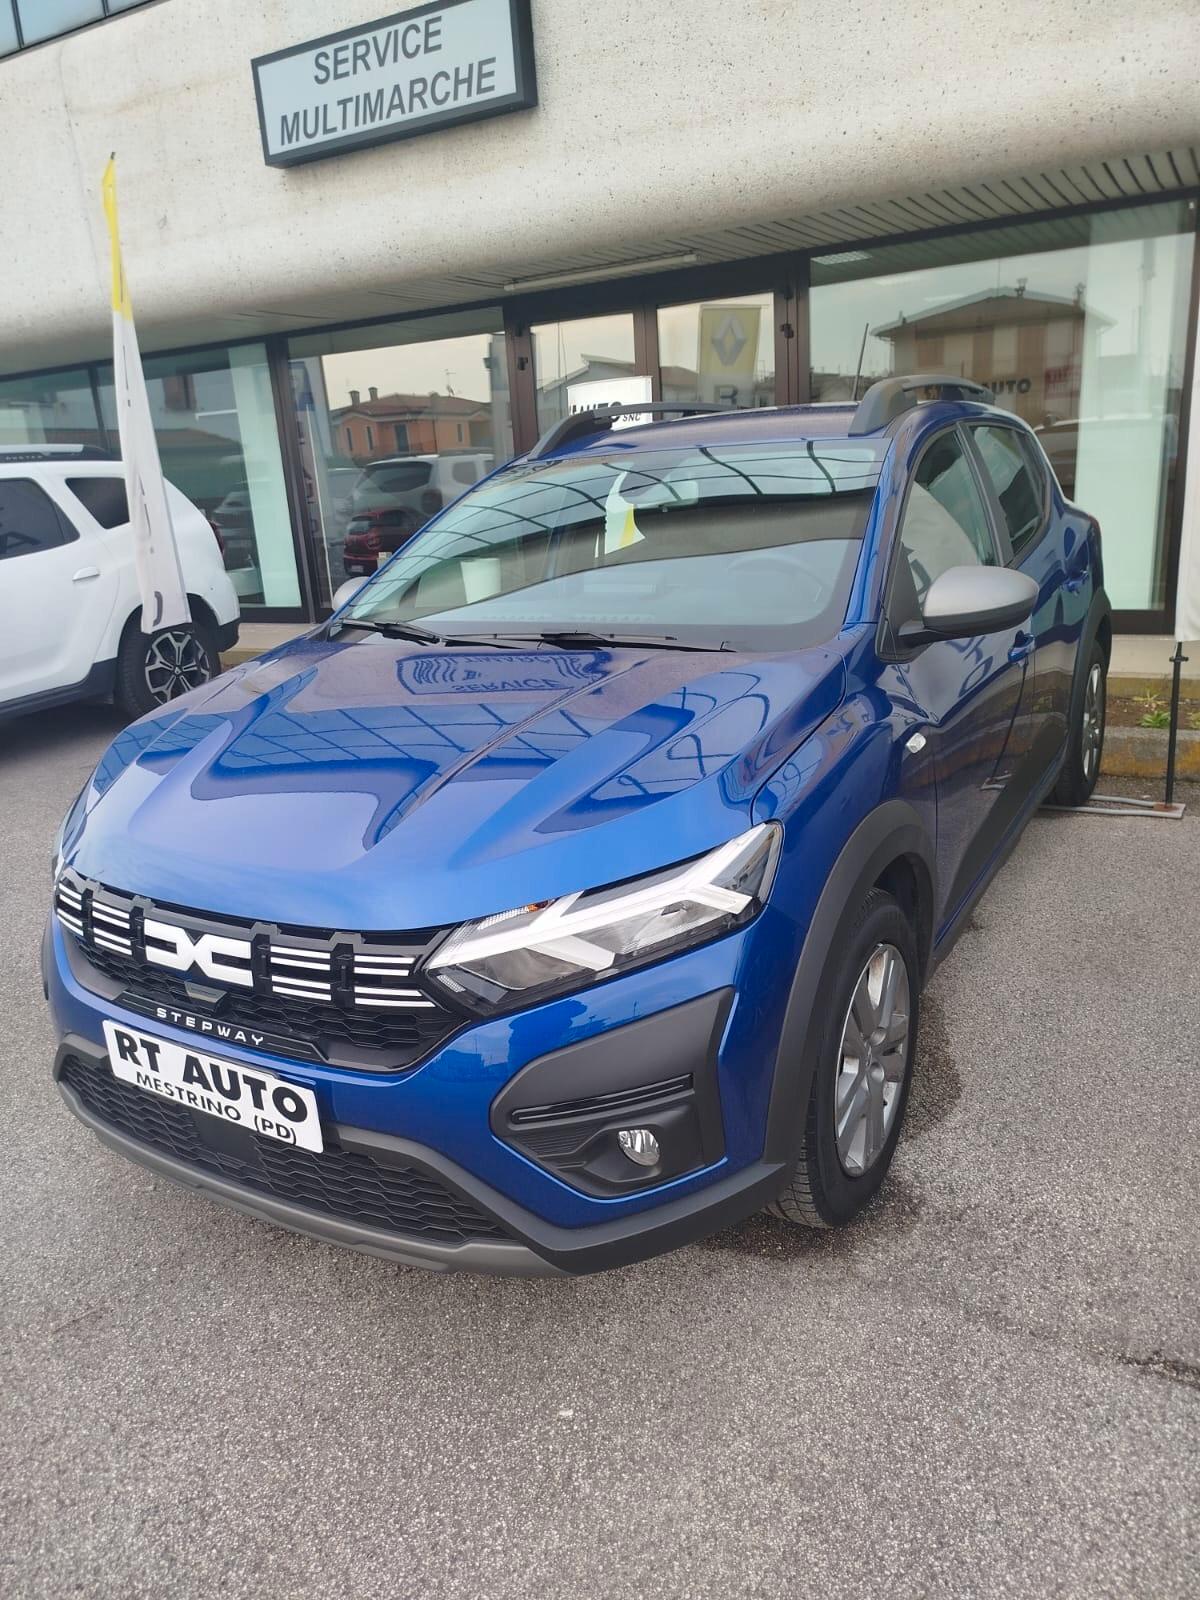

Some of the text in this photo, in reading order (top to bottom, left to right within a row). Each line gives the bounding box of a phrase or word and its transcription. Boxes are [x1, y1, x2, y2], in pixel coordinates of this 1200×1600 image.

[313, 15, 442, 85] SERVICE
[280, 57, 497, 146] MULTIMARCHE
[156, 1007, 264, 1046] STEPWAY
[113, 1029, 308, 1123] RT AUTO
[136, 1071, 297, 1145] MESTRINO (PD)
